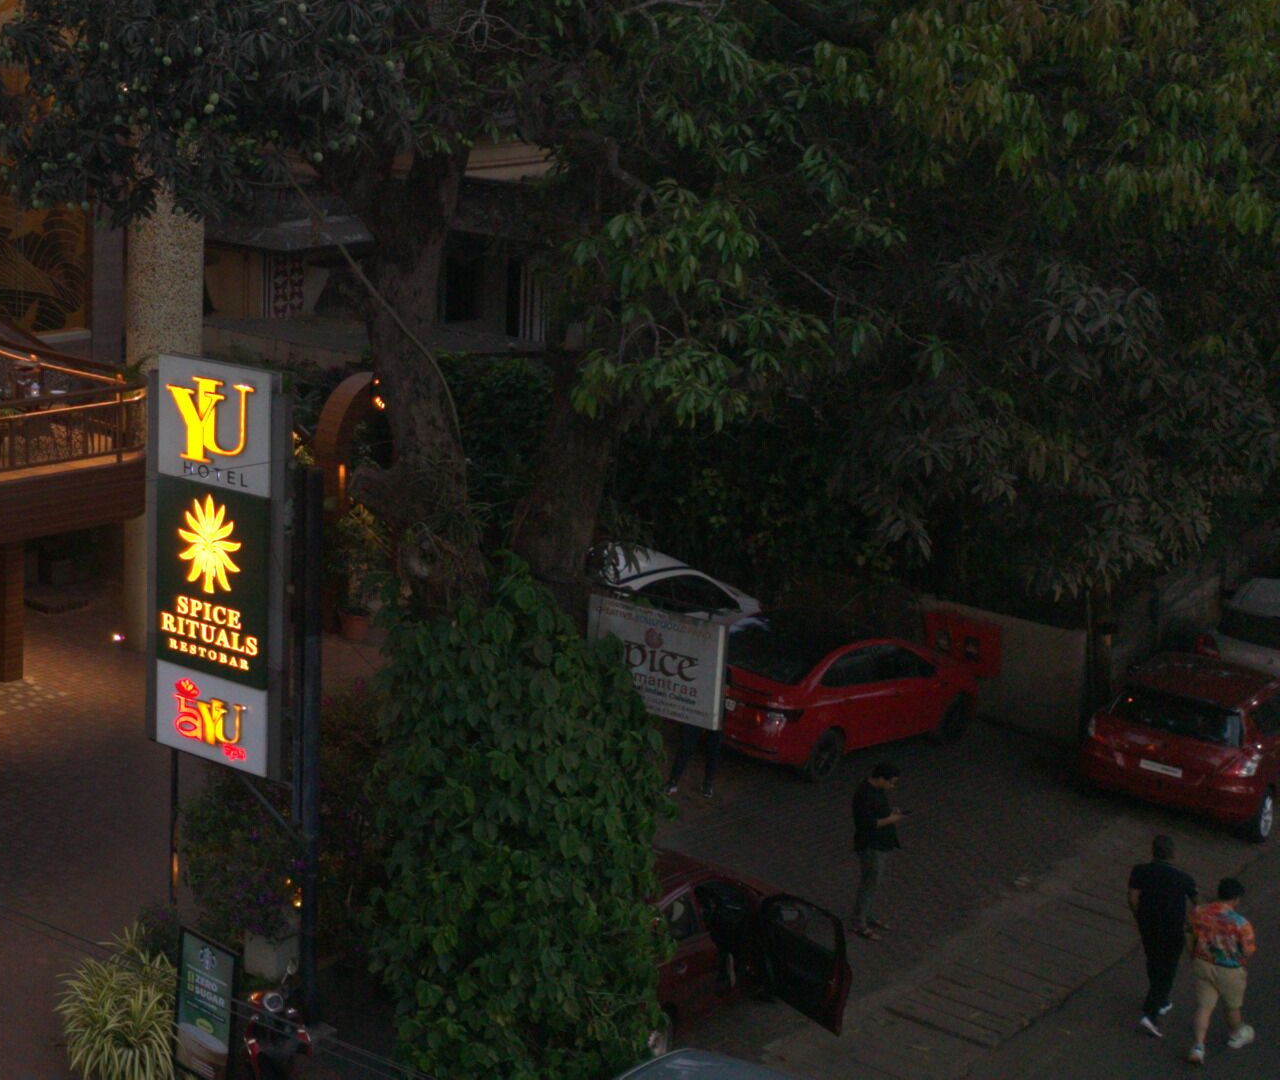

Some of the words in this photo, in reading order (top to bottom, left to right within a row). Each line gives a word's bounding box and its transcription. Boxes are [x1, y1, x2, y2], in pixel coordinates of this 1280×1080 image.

[165, 376, 256, 464] YU
[182, 460, 249, 488] HOTEL
[175, 594, 242, 630] SPICE
[159, 611, 260, 658] RITUALS
[167, 637, 250, 672] RESTOBAR
[624, 639, 699, 681] pice
[195, 986, 226, 1008] SUGAR
